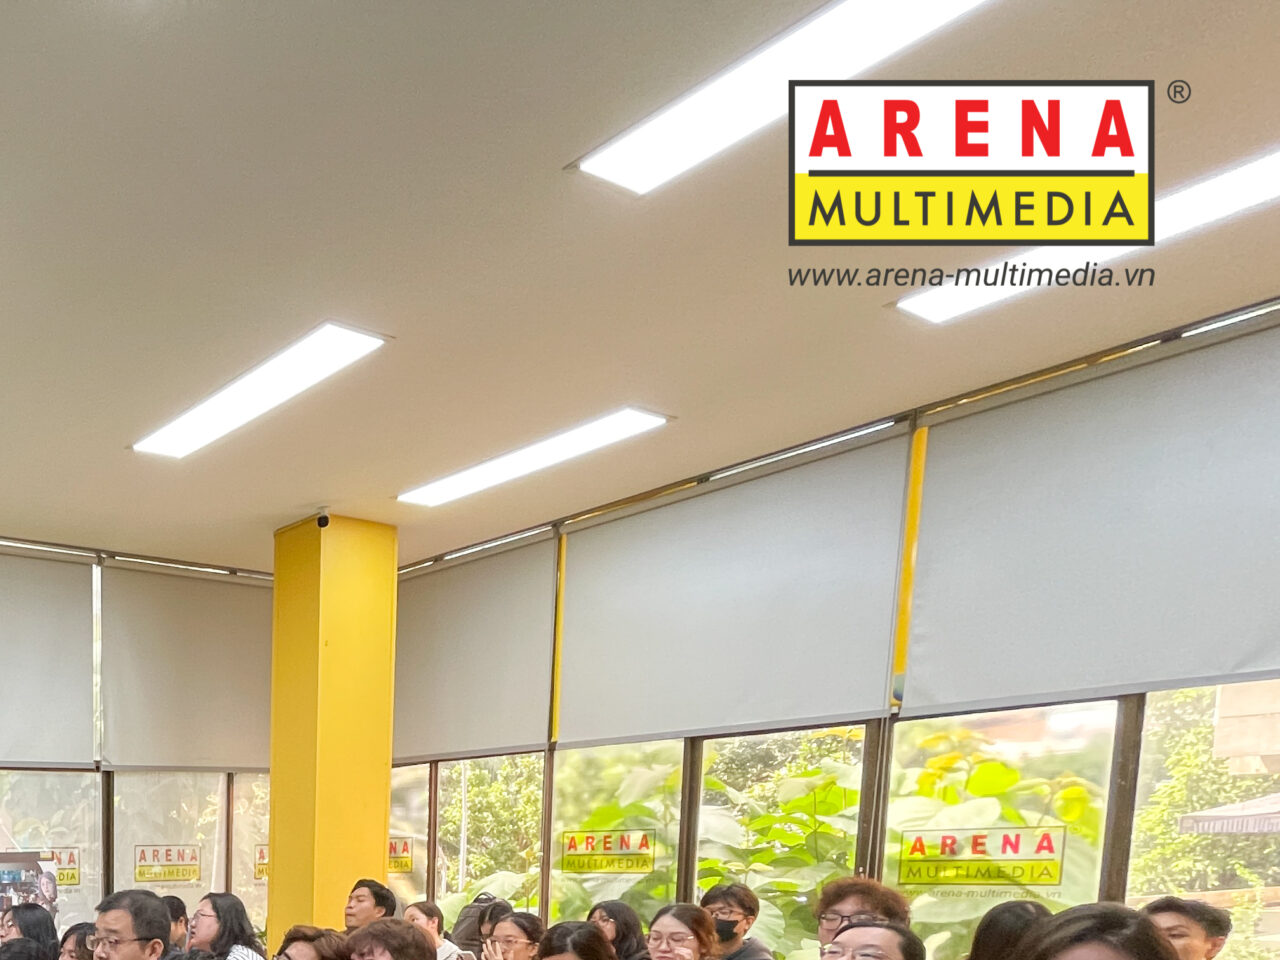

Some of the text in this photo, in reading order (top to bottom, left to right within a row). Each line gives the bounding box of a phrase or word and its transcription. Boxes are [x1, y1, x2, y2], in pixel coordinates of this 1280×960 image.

[567, 833, 650, 852] ARENA
[908, 832, 1056, 856] ARENA
[138, 848, 198, 863] ARENA
[566, 858, 650, 869] MULTIMEDIA
[906, 865, 1054, 879] MULTIMEDIA
